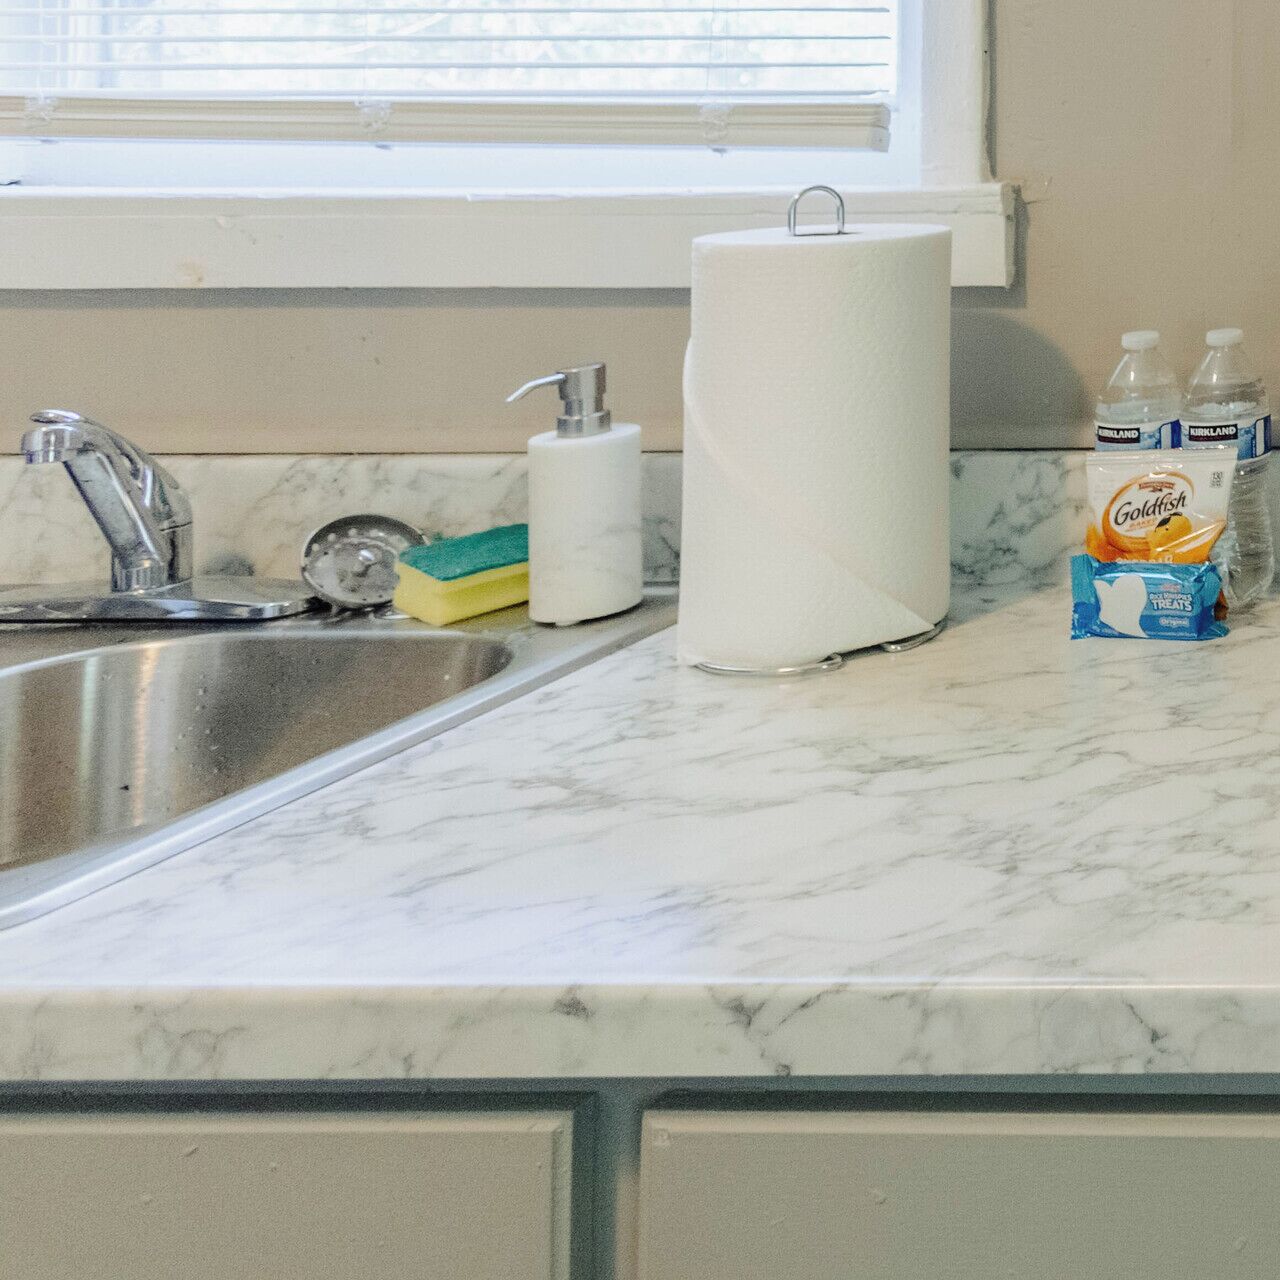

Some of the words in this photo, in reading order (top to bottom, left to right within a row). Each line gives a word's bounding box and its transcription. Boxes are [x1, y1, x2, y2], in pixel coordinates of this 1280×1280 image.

[1099, 429, 1139, 439] KIRKLAND
[1190, 426, 1236, 436] KIRKLAND
[1114, 490, 1187, 526] Goldfish
[1152, 599, 1192, 611] TREATS
